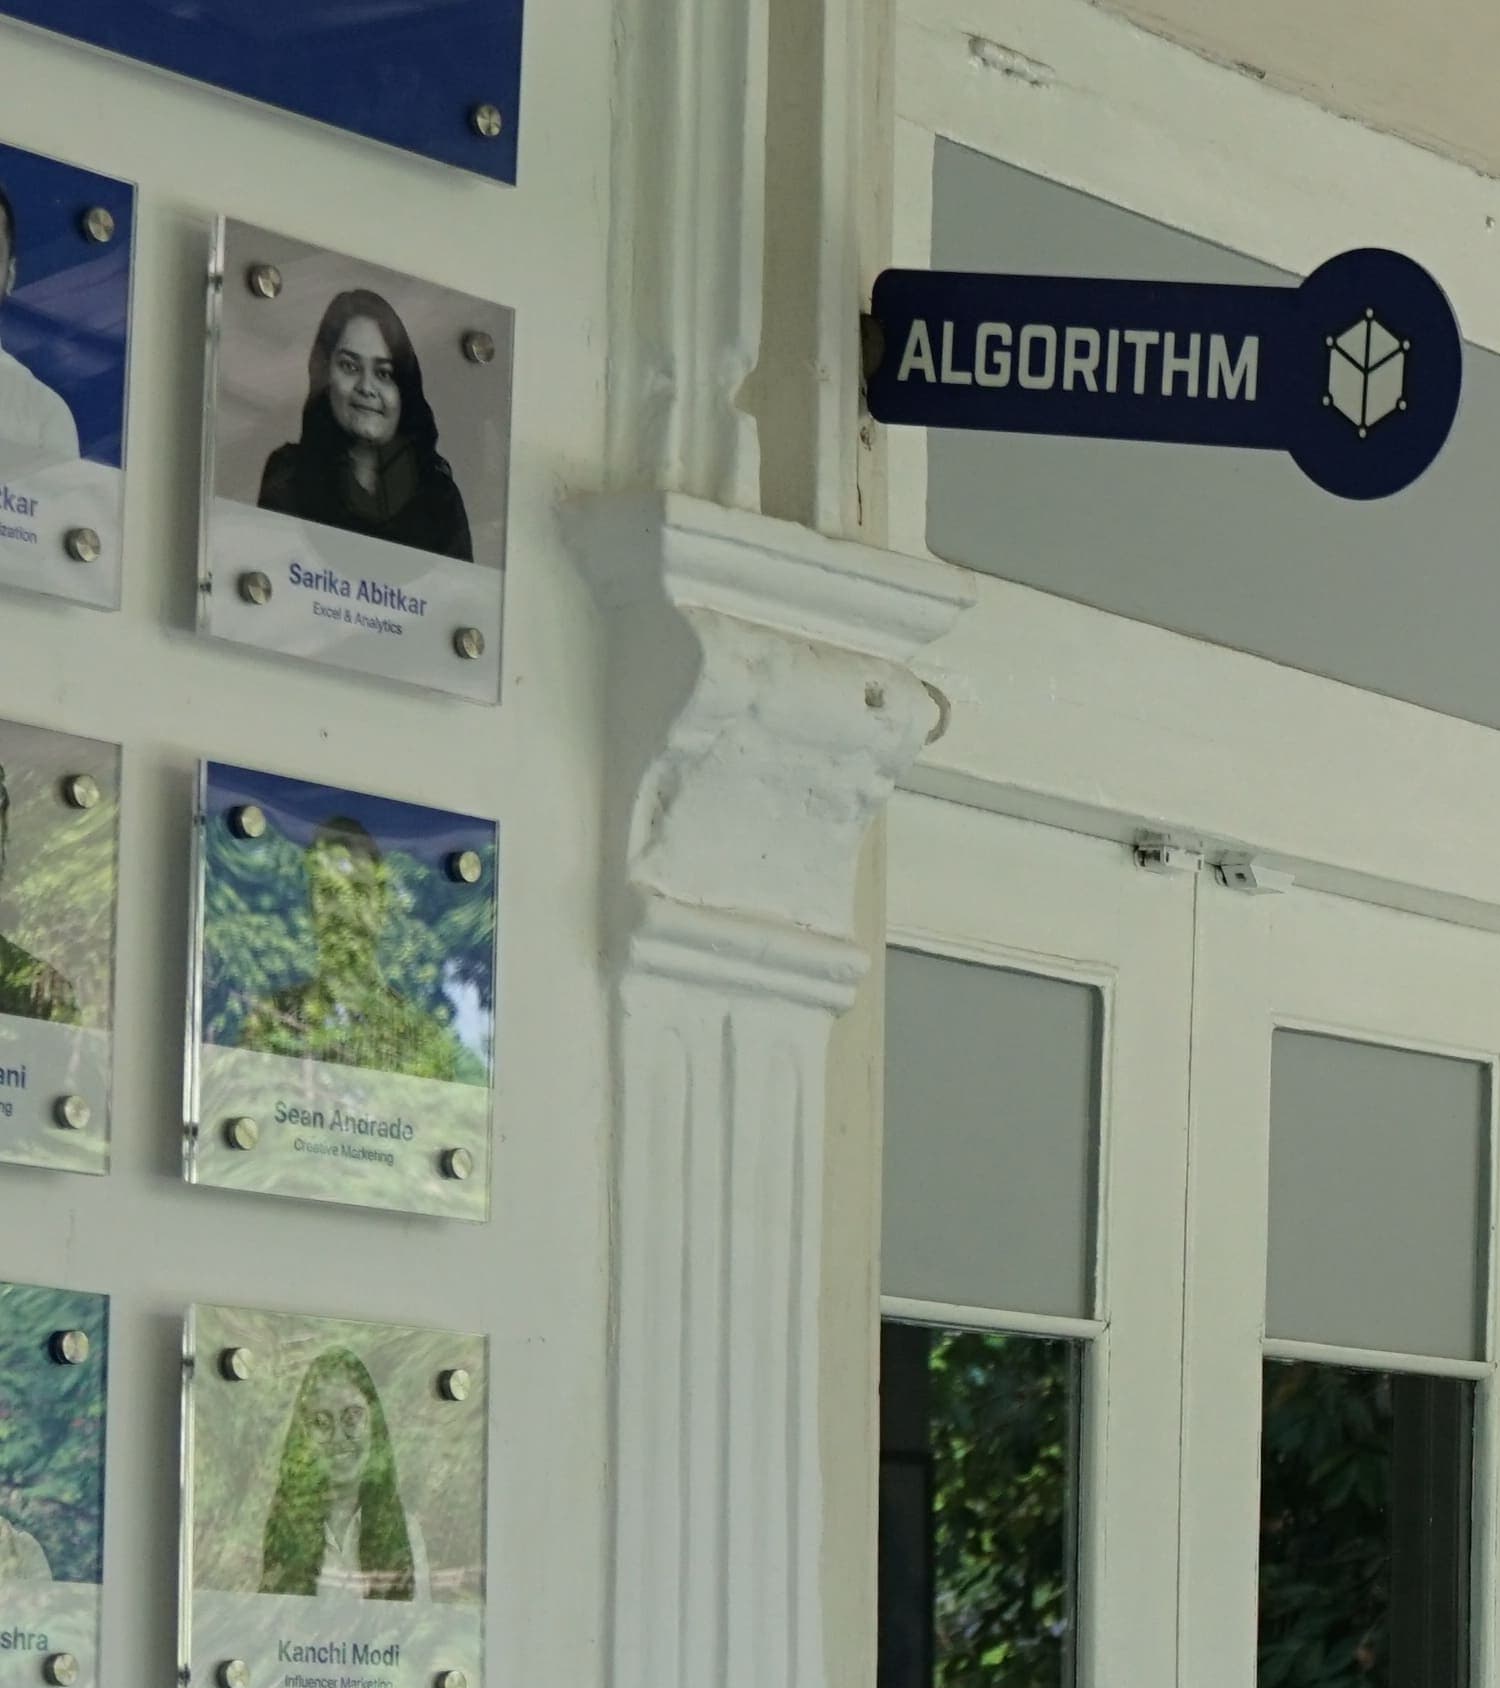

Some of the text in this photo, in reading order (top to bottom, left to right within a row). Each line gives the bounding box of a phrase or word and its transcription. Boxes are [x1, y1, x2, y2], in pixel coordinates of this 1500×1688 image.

[898, 319, 1260, 402] ALGORITHM
[289, 562, 427, 616] Sarika Abitkar
[312, 601, 403, 635] Excel & Analytics
[274, 1100, 414, 1142] Sean Andrade
[278, 1640, 400, 1667] Kanchi Modi
